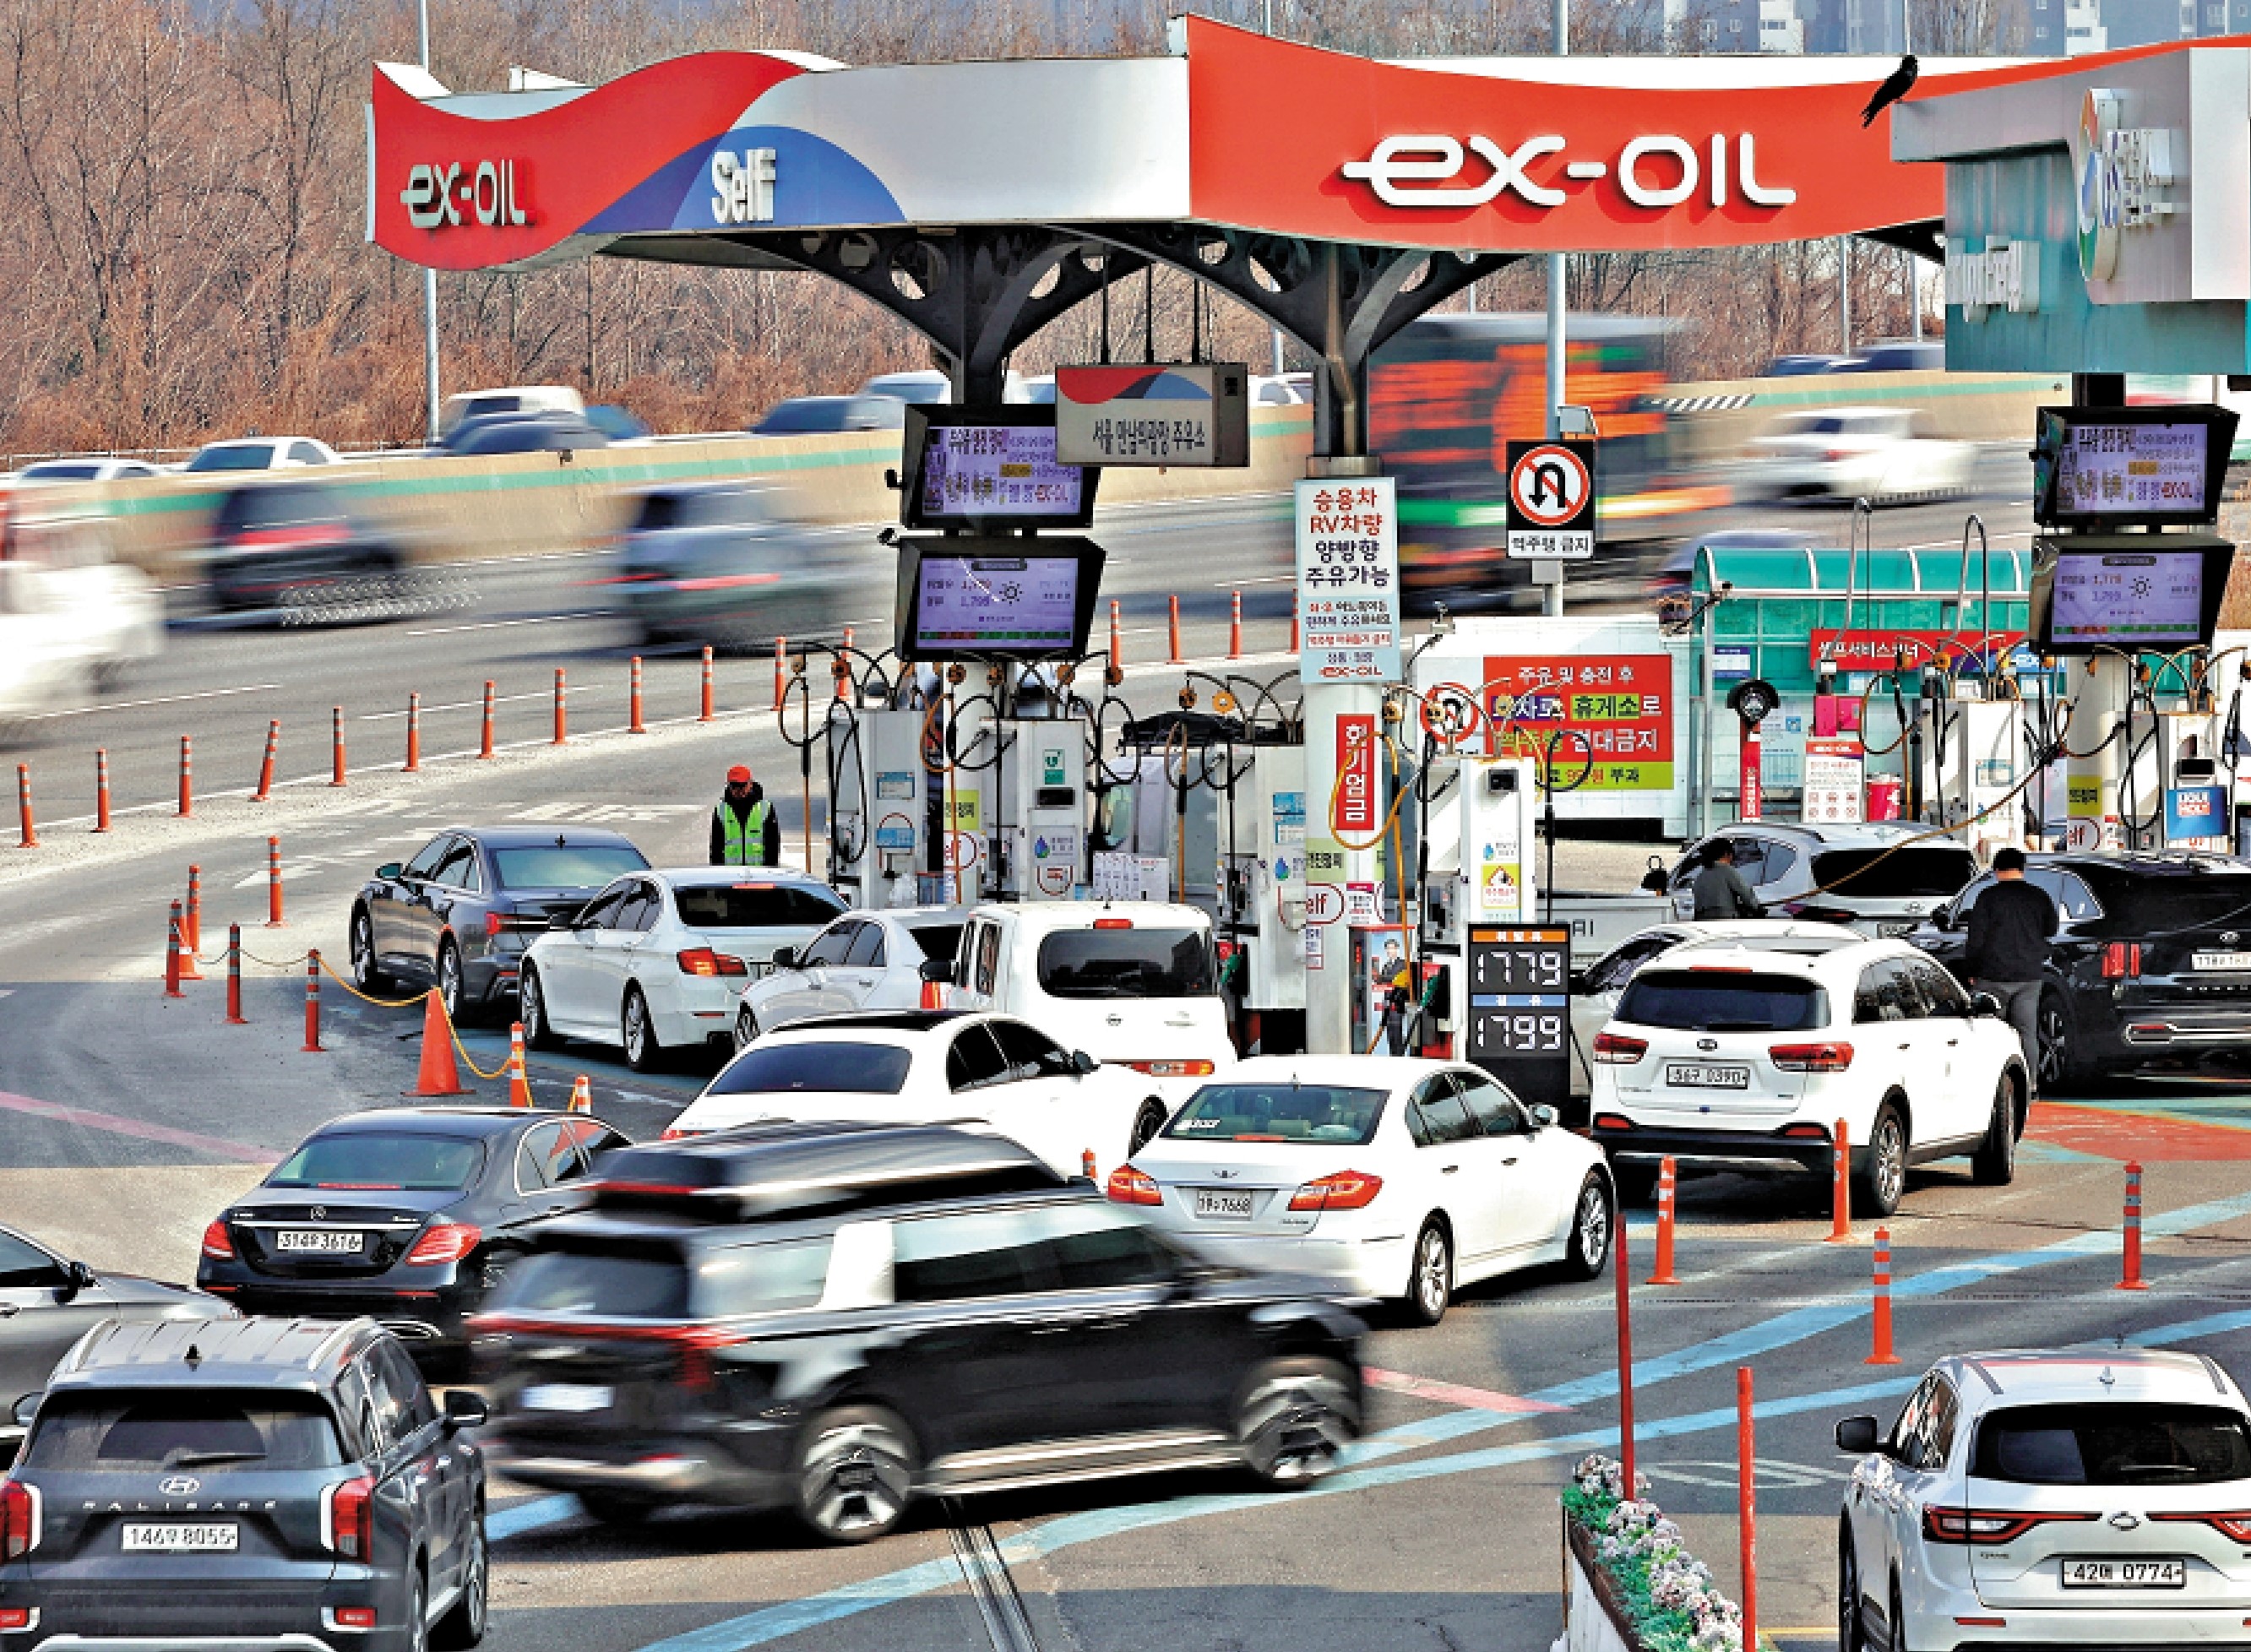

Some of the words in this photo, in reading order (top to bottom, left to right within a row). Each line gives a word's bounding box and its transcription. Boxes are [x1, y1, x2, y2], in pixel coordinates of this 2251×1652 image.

[1341, 132, 1797, 209] ex-OIL
[400, 159, 527, 229] ex-OIL
[1172, 418, 1205, 452] 주유소
[1313, 486, 1378, 513] 승용차
[1310, 514, 1383, 535] RV차량
[1315, 538, 1379, 563] 양방향
[1306, 565, 1390, 589] 주유가능
[1519, 666, 1553, 685] 주유
[1574, 695, 1662, 717] 휴게소로
[1345, 723, 1367, 823] 화기엄금
[1477, 951, 1562, 986] 1779
[1477, 1015, 1562, 1050] 1799
[2122, 1563, 2173, 1582] 0774
